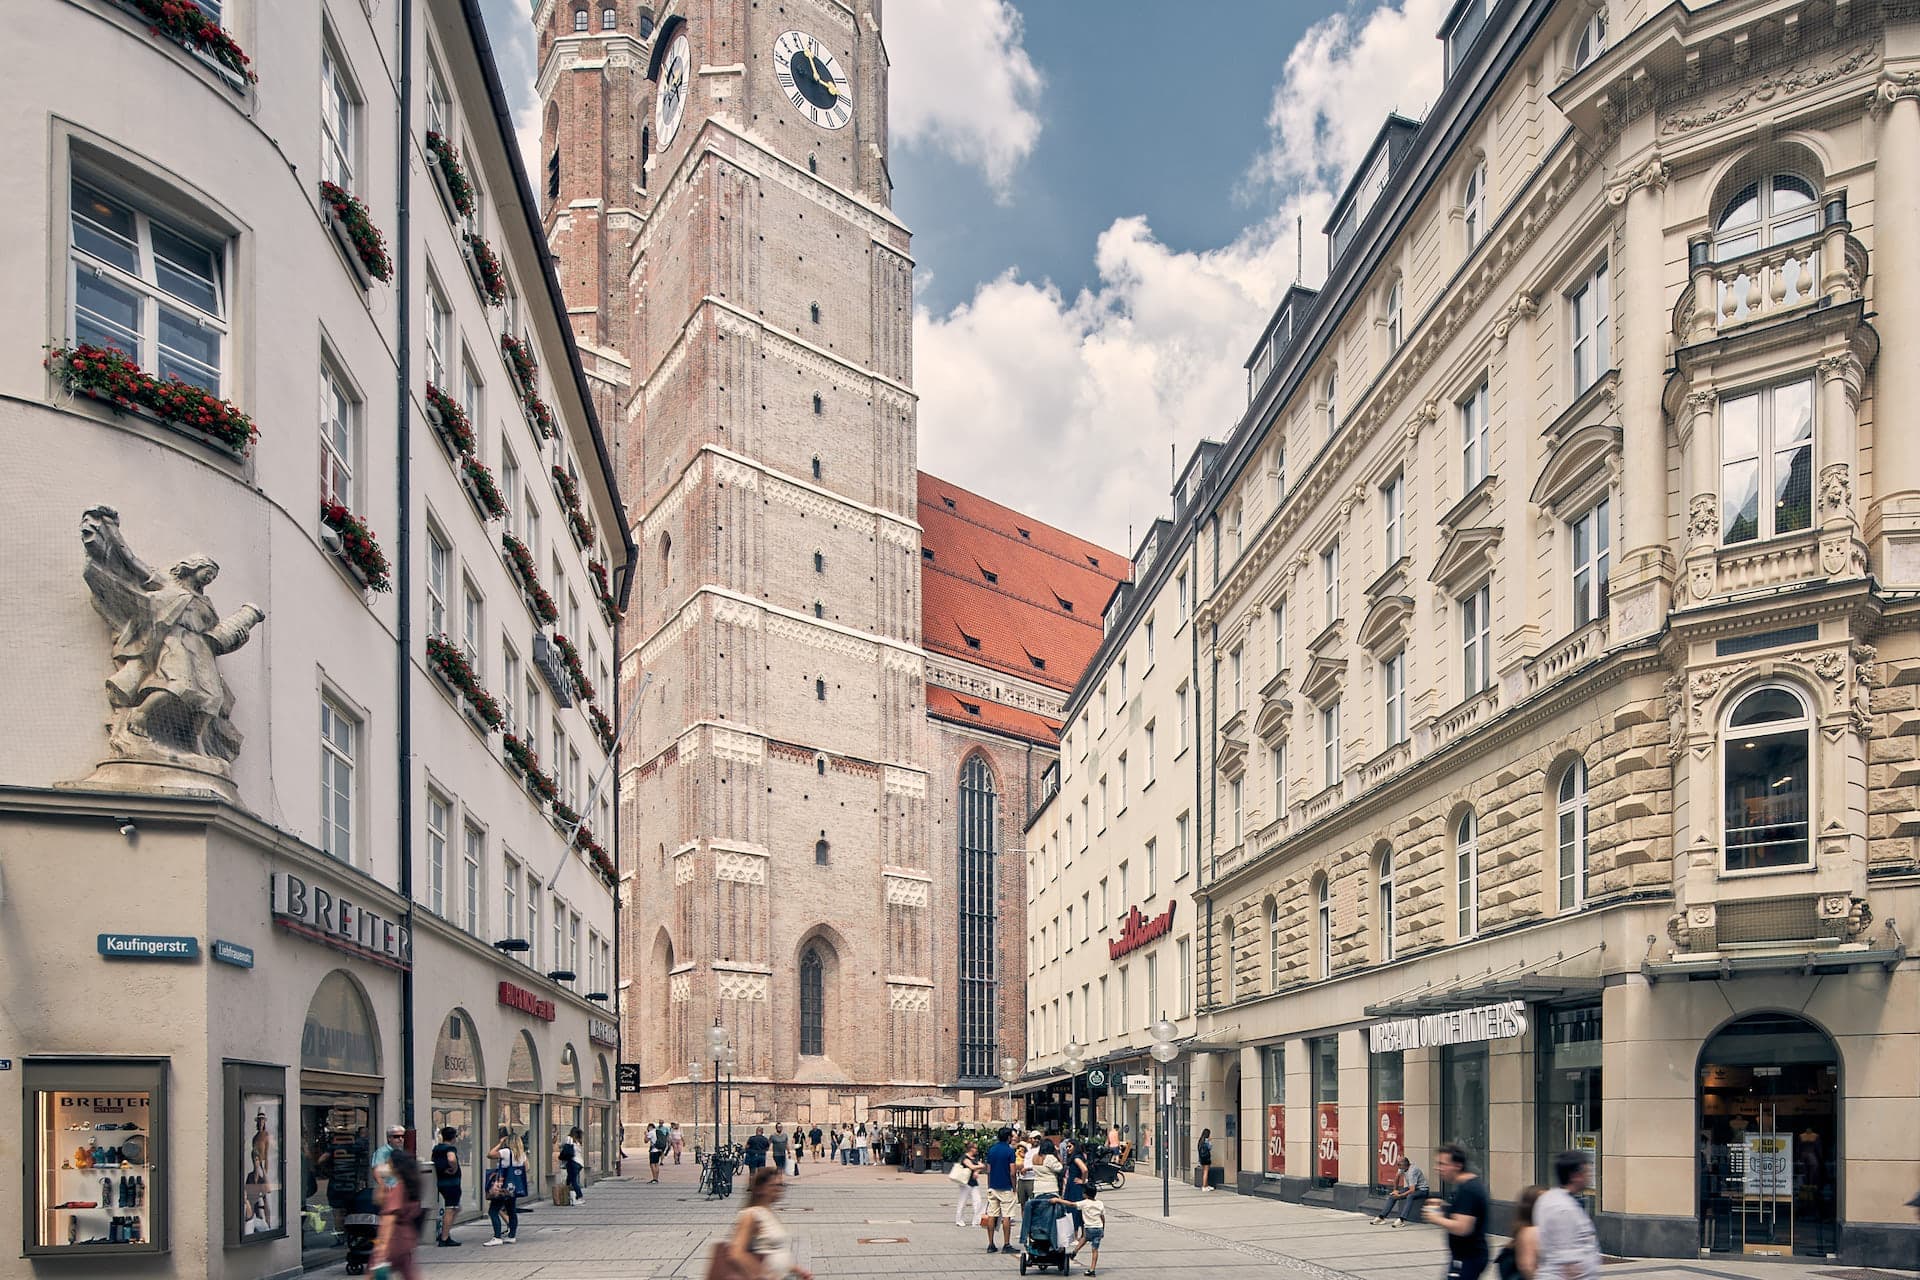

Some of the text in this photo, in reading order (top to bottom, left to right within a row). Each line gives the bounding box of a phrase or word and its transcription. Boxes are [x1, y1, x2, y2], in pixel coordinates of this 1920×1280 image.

[284, 872, 411, 960] BREITER
[106, 937, 189, 954] Kaufingerstr.
[594, 1020, 618, 1045] BREITE
[1369, 1000, 1527, 1054] URBAN OUTFITTERS
[60, 1097, 150, 1107] BREITER
[334, 1148, 357, 1191] CAMP
